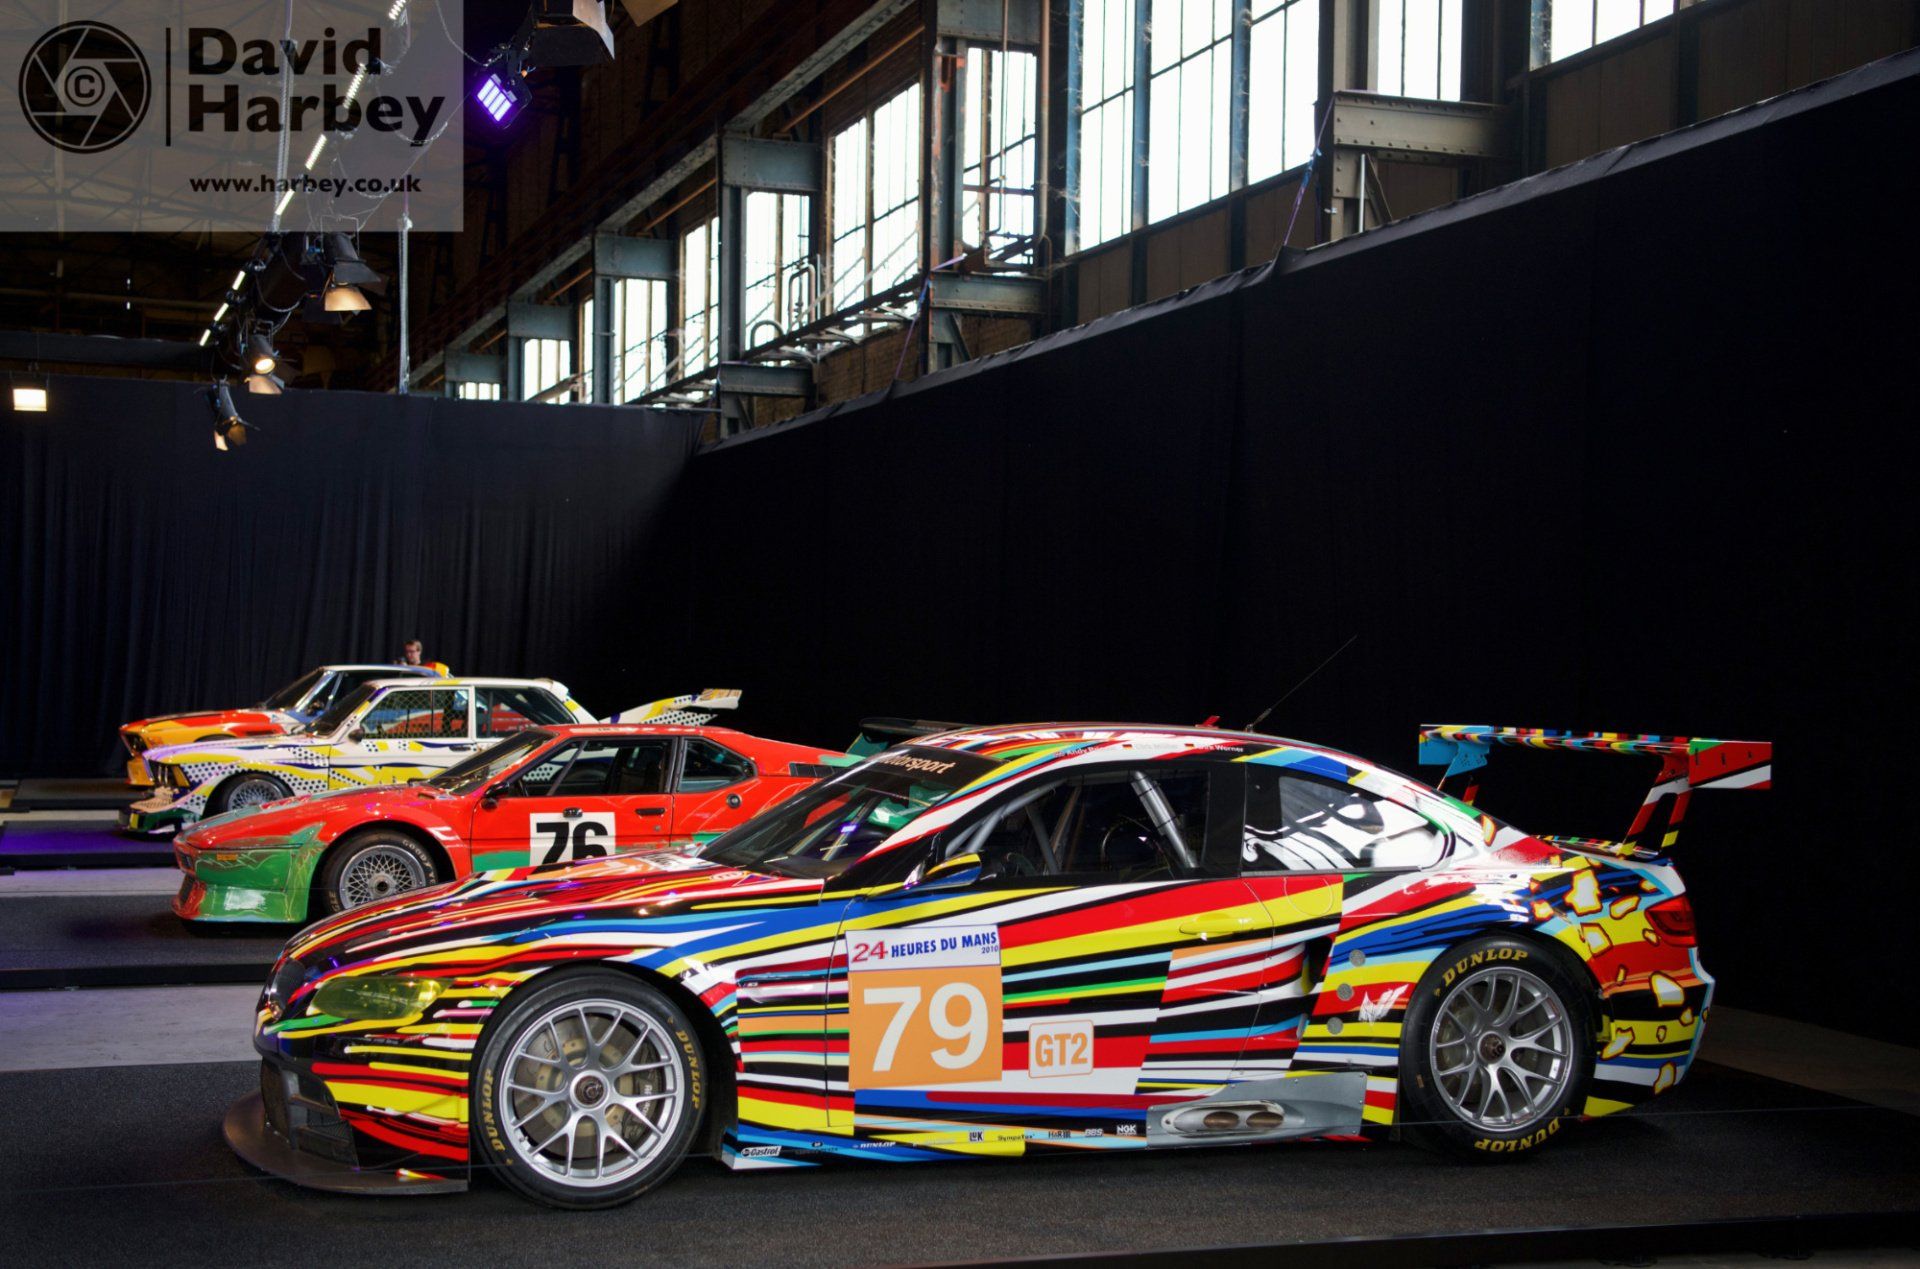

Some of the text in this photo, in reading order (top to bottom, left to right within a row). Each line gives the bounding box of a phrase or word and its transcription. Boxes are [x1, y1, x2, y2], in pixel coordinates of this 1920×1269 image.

[536, 821, 609, 867] 76
[851, 932, 997, 963] 24 HEURES DU MANS
[981, 945, 999, 955] 2010
[1442, 947, 1529, 987] DUNLOP
[863, 982, 989, 1072] 79
[1035, 1032, 1088, 1068] GT2
[675, 1029, 701, 1110] DUNLOP
[478, 1068, 506, 1152] DUNLOP
[1084, 1128, 1103, 1137] BBS
[1116, 1125, 1137, 1135] NGK
[1474, 1117, 1561, 1154] DUNLOP
[750, 1147, 779, 1156] Castrol
